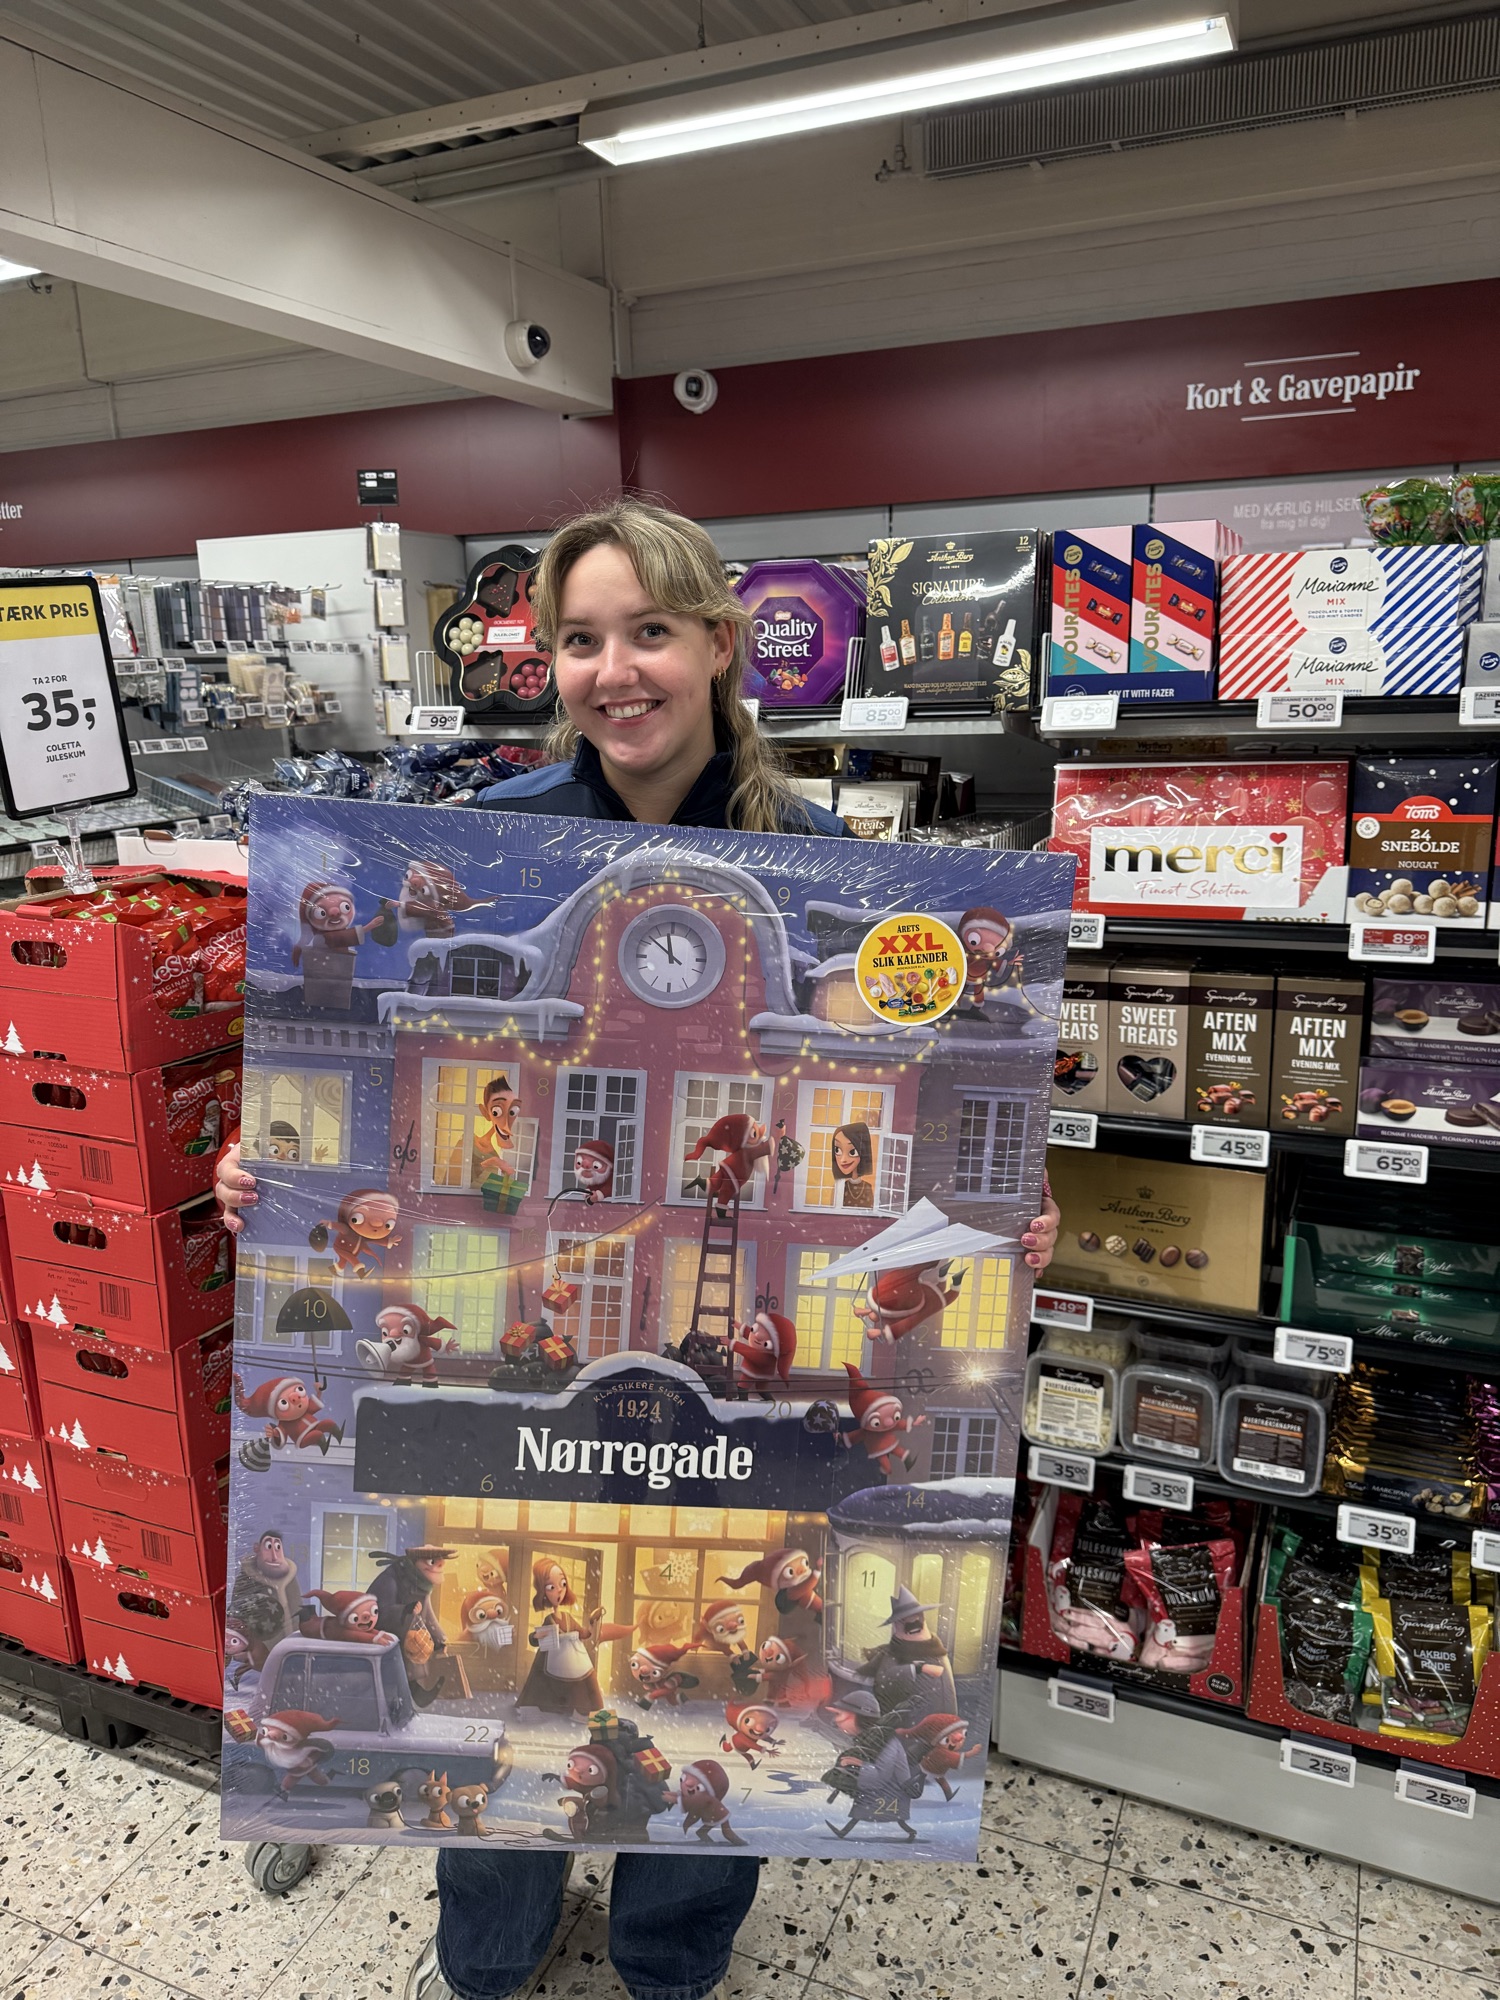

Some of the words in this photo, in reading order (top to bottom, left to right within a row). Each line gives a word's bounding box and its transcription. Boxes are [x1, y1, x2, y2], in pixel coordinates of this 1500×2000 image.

[1186, 380, 1243, 410] Kort
[1249, 377, 1272, 404] &
[1278, 362, 1421, 403] Gavepapir
[1233, 505, 1260, 518] MED
[1263, 501, 1312, 516] KÆRLIG
[1276, 519, 1295, 531] mig
[1019, 535, 1029, 545] 12
[927, 551, 955, 563] Anthon
[956, 551, 974, 564] Berg
[1296, 577, 1379, 599] Marianne
[50, 602, 89, 618] PRIS
[754, 619, 817, 644] Quality
[757, 640, 812, 658] Street
[1295, 657, 1378, 678] Marianne
[33, 677, 44, 685] TA
[45, 676, 50, 684] 2
[51, 675, 67, 683] FOR
[1108, 690, 1122, 698] SAY
[1130, 689, 1150, 697] WITH
[1152, 688, 1175, 697] FAZER
[46, 741, 81, 752] COLETTA
[46, 750, 86, 763] JULESKUM
[1404, 805, 1441, 820] Toms
[851, 818, 885, 831] Treats
[1410, 829, 1431, 841] 24
[1104, 834, 1286, 874] merci
[1381, 841, 1460, 853] SNEBOLDE
[1398, 861, 1439, 869] NOUGAT
[519, 868, 542, 888] 15
[778, 886, 791, 906] 9
[1136, 879, 1186, 898] Finest
[1187, 880, 1251, 899] Selection
[877, 932, 943, 955] XXL
[873, 955, 896, 968] SLIK
[897, 952, 948, 966] KALENDER
[1124, 986, 1175, 1002] Spangsberg
[1205, 990, 1257, 1006] Spangsberg
[1292, 994, 1347, 1011] Spangsberg
[1435, 996, 1464, 1006] Anthon
[1464, 998, 1483, 1009] Berg
[1121, 1006, 1177, 1027] SWEET
[1203, 1011, 1257, 1032] AFTEN
[1118, 1025, 1178, 1046] TREATS
[1290, 1016, 1346, 1038] AFTEN
[1212, 1032, 1247, 1052] MIX
[1298, 1038, 1335, 1058] MIX
[1205, 1053, 1236, 1063] EVENING
[1237, 1056, 1252, 1064] MIX
[1291, 1059, 1323, 1070] EVENING
[1325, 1062, 1340, 1071] MIX
[370, 1067, 383, 1086] 5
[537, 1078, 549, 1096] 8
[1422, 1087, 1451, 1097] Anthon
[1452, 1090, 1471, 1100] Berg
[775, 1092, 795, 1111] 12
[922, 1122, 948, 1142] 23
[1381, 1130, 1406, 1138] BLOMME
[1411, 1132, 1438, 1140] MADEIRA
[1442, 1135, 1474, 1144] PLOMMON
[1100, 1200, 1155, 1219] Anthon
[1155, 1207, 1191, 1227] Berg
[1358, 1251, 1400, 1268] After
[1417, 1257, 1455, 1276] Eight
[304, 1300, 327, 1318] 10
[1357, 1324, 1401, 1339] After
[1413, 1330, 1453, 1345] Eight
[593, 1382, 654, 1404] KLASSIKERE
[658, 1386, 685, 1407] SIDEN
[617, 1399, 661, 1420] 1924
[764, 1401, 792, 1418] 20
[514, 1427, 753, 1489] Nørregade
[480, 1474, 494, 1492] 6
[1372, 1485, 1410, 1497] MARCIPAN
[905, 1491, 926, 1509] 14
[659, 1563, 673, 1581] 4
[862, 1571, 877, 1588] 11
[1070, 1565, 1121, 1582] JULESKUM
[1399, 1614, 1465, 1636] Spangsberg
[1413, 1650, 1457, 1662] LAKRIDS
[464, 1726, 490, 1743] 22
[348, 1758, 370, 1775] 18
[740, 1787, 753, 1803] 7
[873, 1798, 899, 1815] 24
